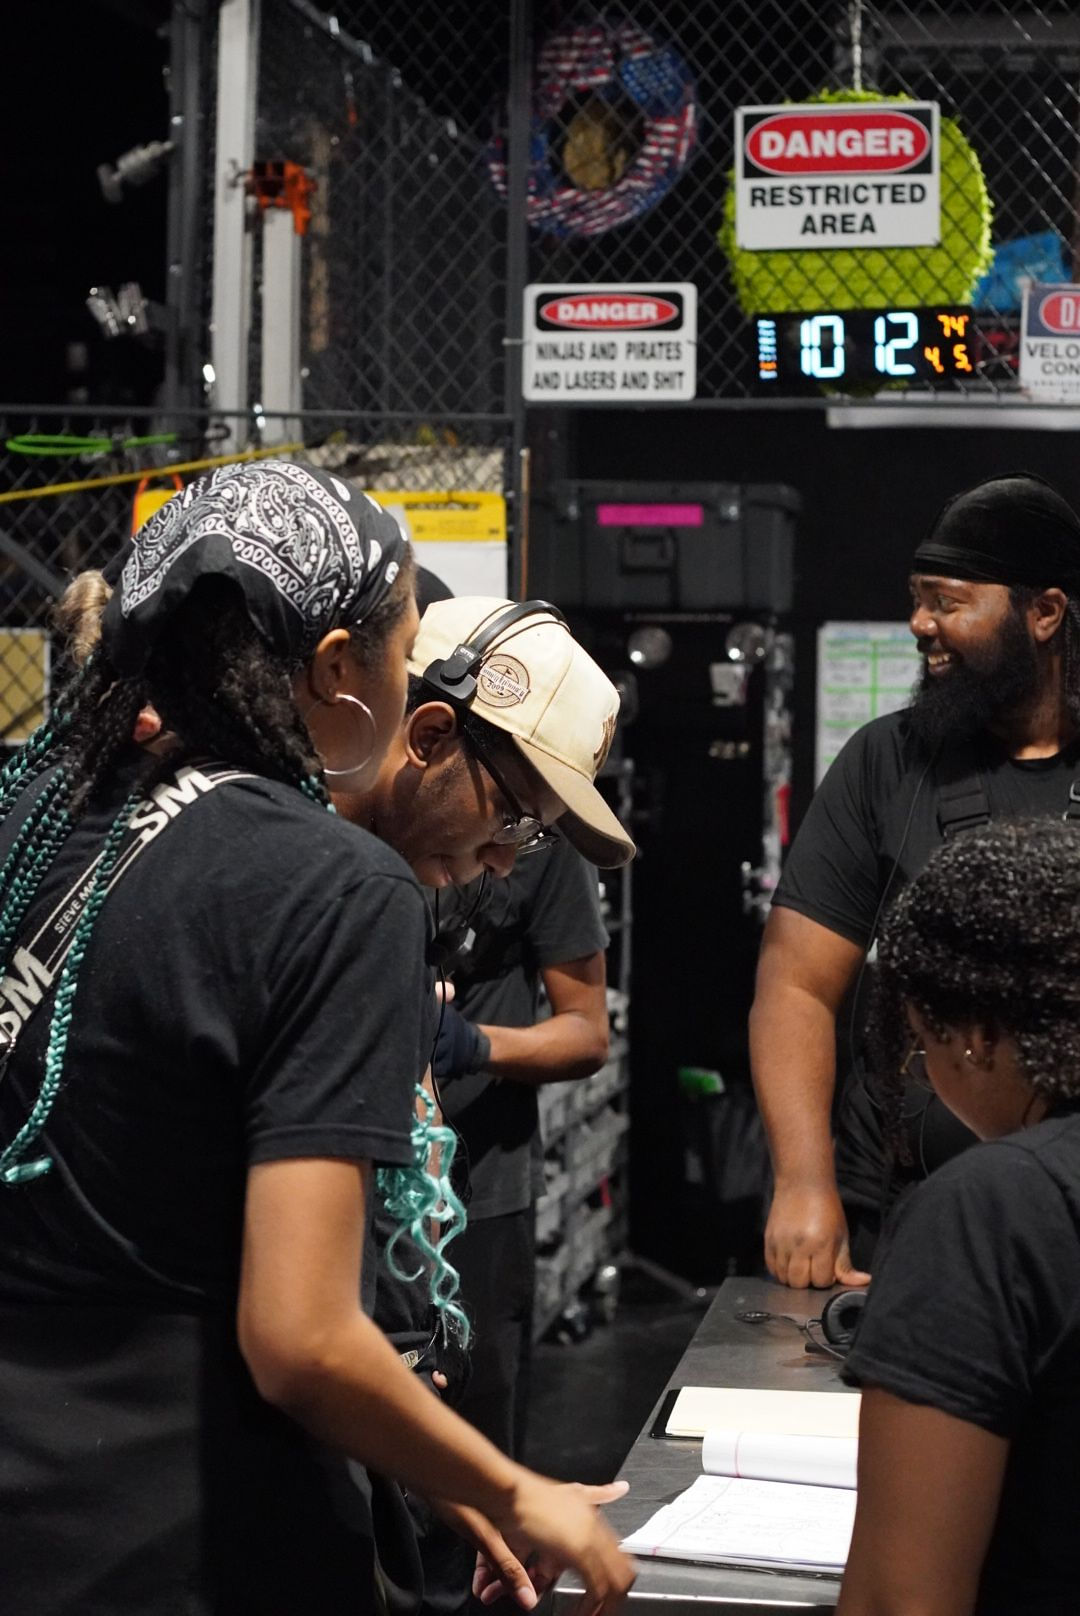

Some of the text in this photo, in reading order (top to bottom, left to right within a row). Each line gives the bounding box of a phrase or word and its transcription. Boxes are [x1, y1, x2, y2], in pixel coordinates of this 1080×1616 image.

[759, 127, 916, 160] DANGER
[750, 183, 927, 208] RESTRICTED
[800, 213, 877, 236] AREA
[556, 302, 658, 321] DANGER
[1059, 297, 1080, 328] D
[535, 340, 683, 361] NINJAS AND PIRATES
[800, 315, 845, 378] 10
[874, 312, 919, 376] 12
[532, 371, 685, 391] AND LASERS AND SHIT
[127, 766, 216, 844] SM
[54, 900, 82, 934] STEVE
